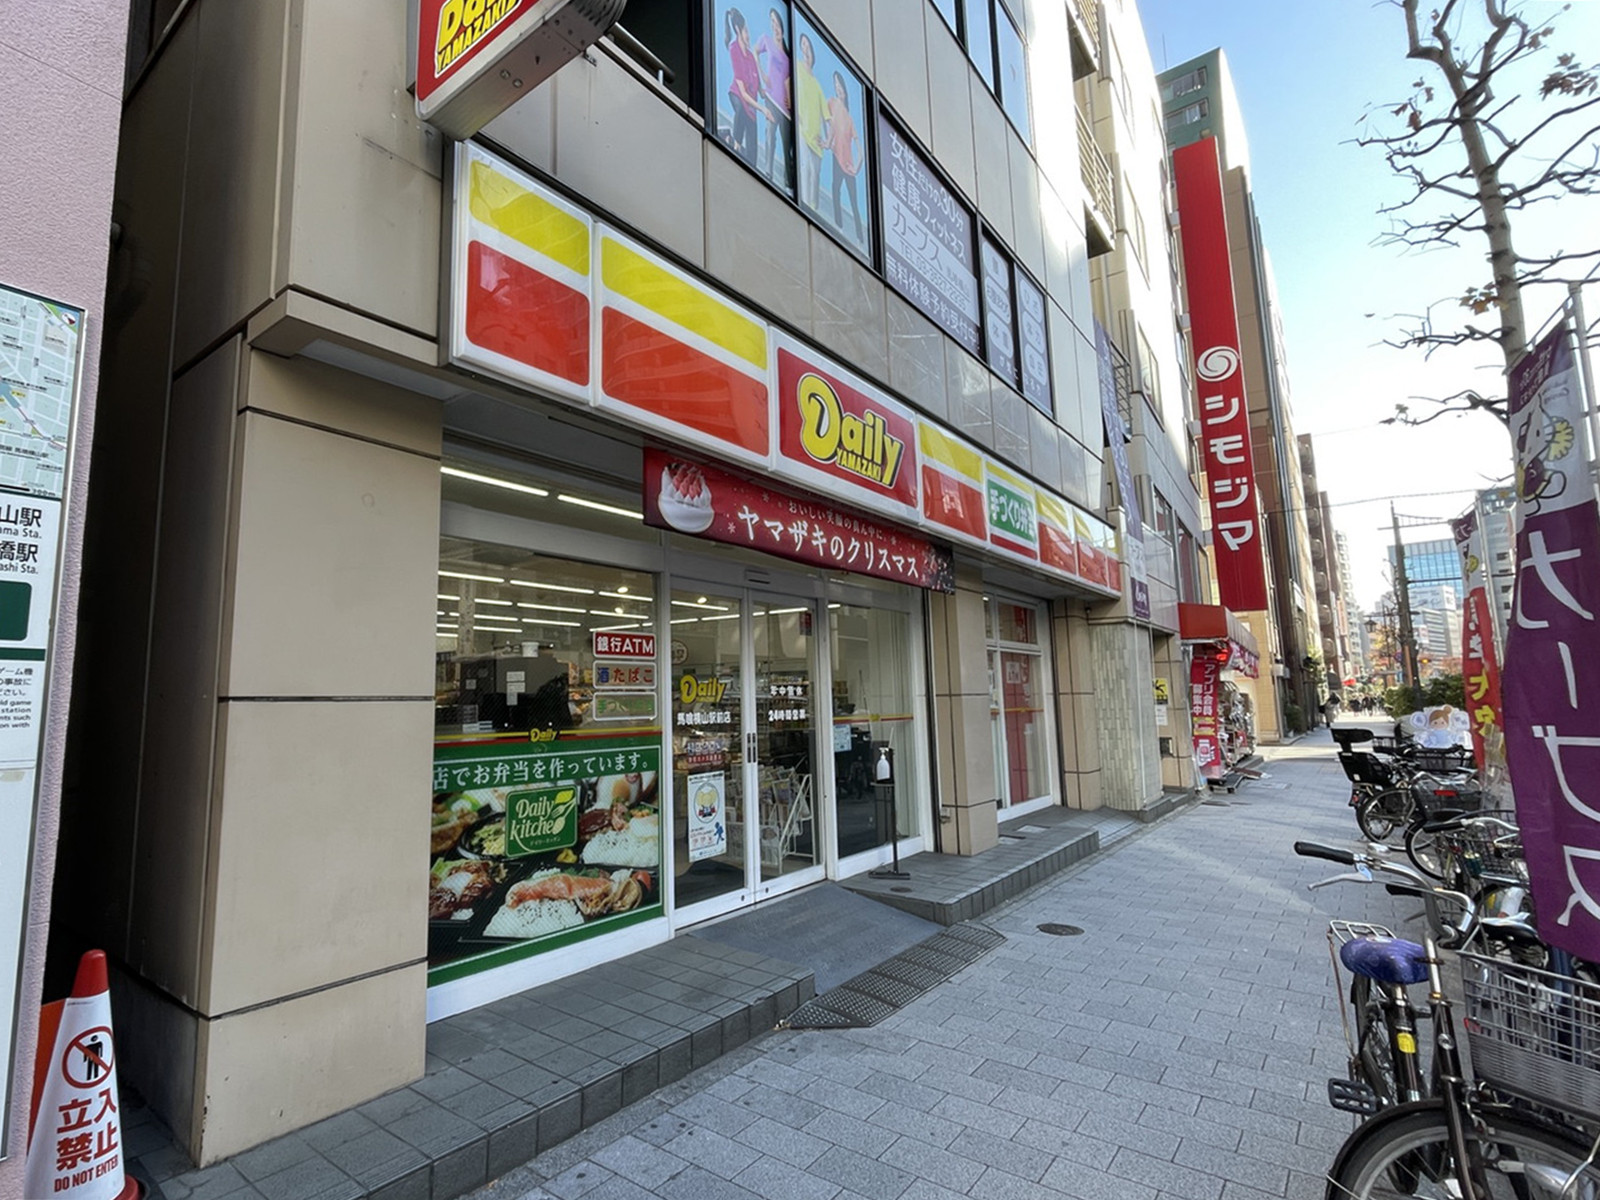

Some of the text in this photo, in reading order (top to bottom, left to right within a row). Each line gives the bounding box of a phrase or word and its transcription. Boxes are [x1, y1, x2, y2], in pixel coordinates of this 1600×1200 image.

[799, 374, 904, 488] Daily
[836, 447, 882, 482] YAMAZAKI
[1204, 394, 1254, 551] シモジマ
[22, 528, 42, 539] Sta.
[737, 505, 919, 579] ヤマザキのクリスマス
[21, 563, 38, 575] Sta.
[597, 636, 653, 654] 銀行ATM
[681, 674, 728, 704] Daily
[530, 728, 558, 742] Daily
[515, 795, 555, 822] Daily
[56, 1088, 117, 1134] 立入
[56, 1122, 118, 1172] 禁止
[54, 1176, 70, 1192] DO
[72, 1167, 94, 1187] NOT
